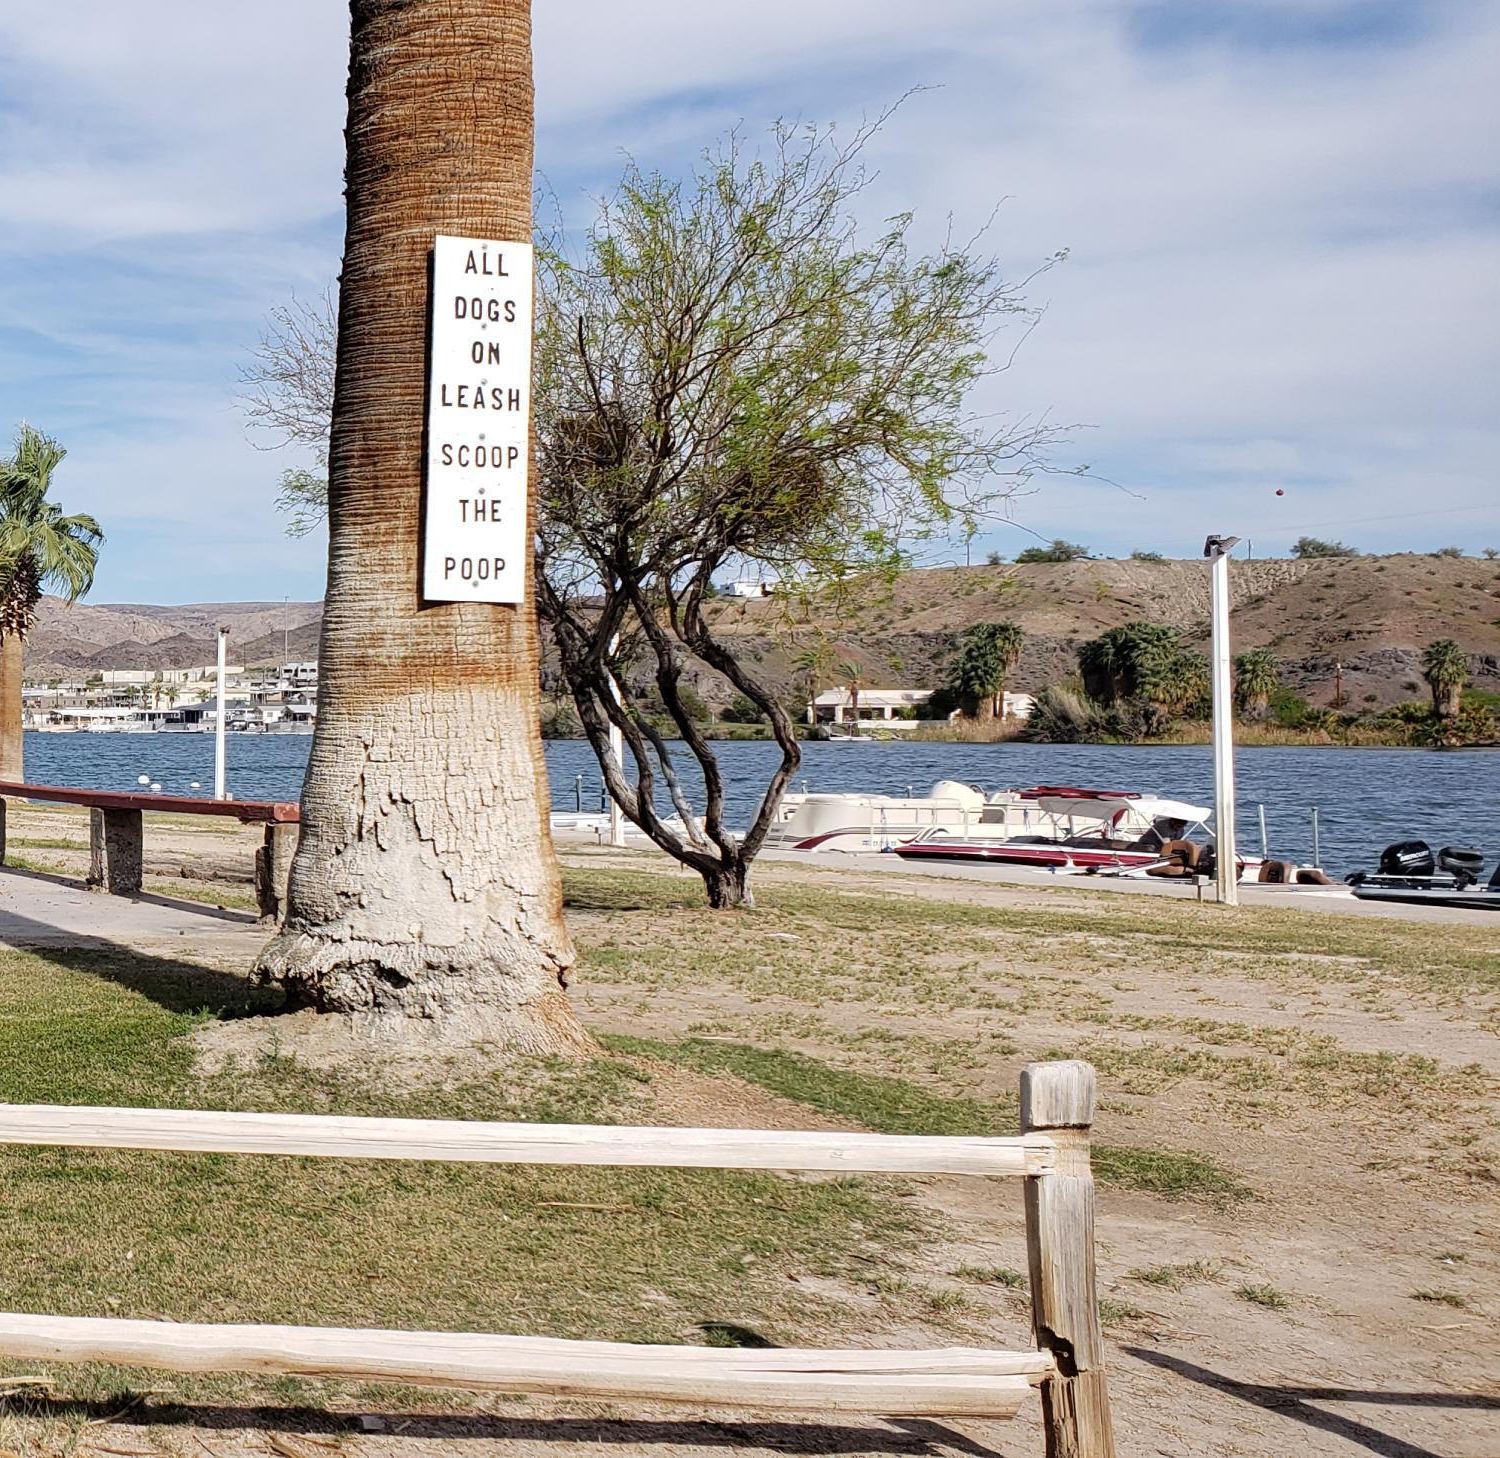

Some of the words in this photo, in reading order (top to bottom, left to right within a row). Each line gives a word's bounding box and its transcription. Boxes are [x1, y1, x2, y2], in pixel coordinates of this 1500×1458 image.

[464, 250, 510, 277] ALL
[454, 296, 517, 323] DOGS
[471, 341, 501, 366] ON
[441, 384, 521, 412] LEASH
[441, 444, 520, 469] SCOOP
[458, 499, 502, 523] THE
[444, 557, 506, 581] POOP
